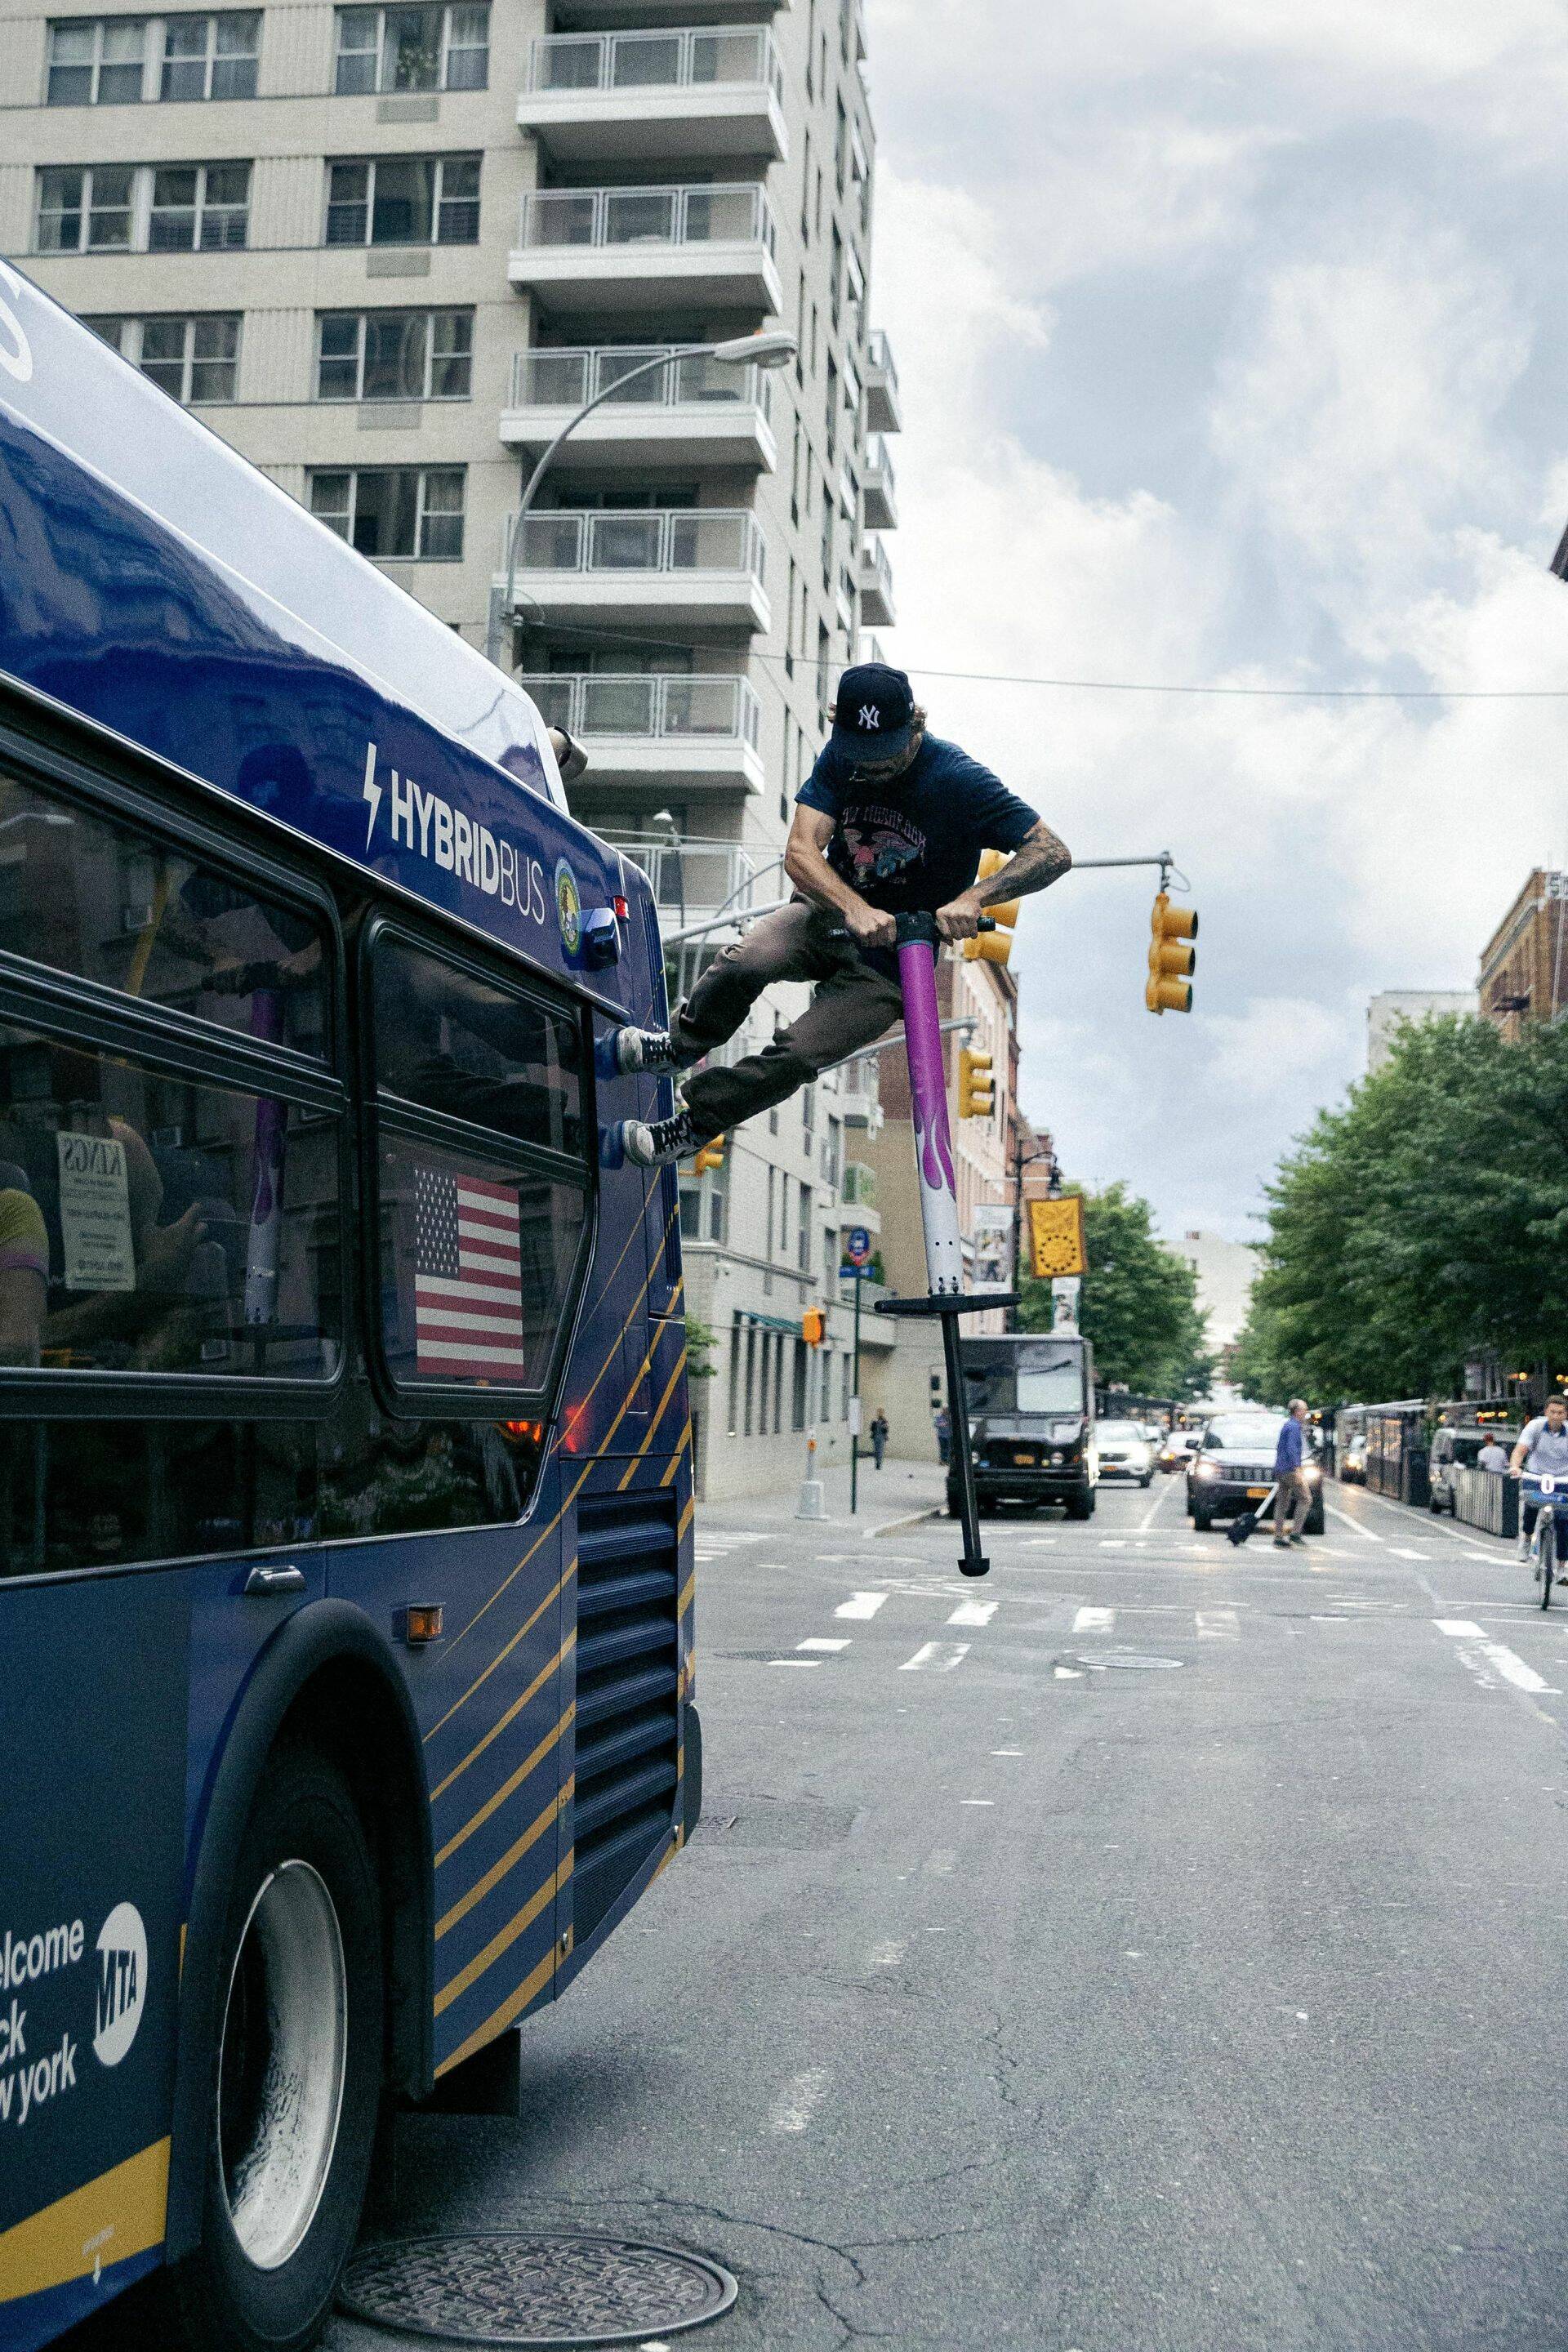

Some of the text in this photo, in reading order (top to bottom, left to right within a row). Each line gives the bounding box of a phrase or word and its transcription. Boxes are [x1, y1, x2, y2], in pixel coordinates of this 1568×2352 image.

[858, 704, 880, 729] NY
[0, 1918, 84, 1990] lcome
[18, 2032, 78, 2126] york
